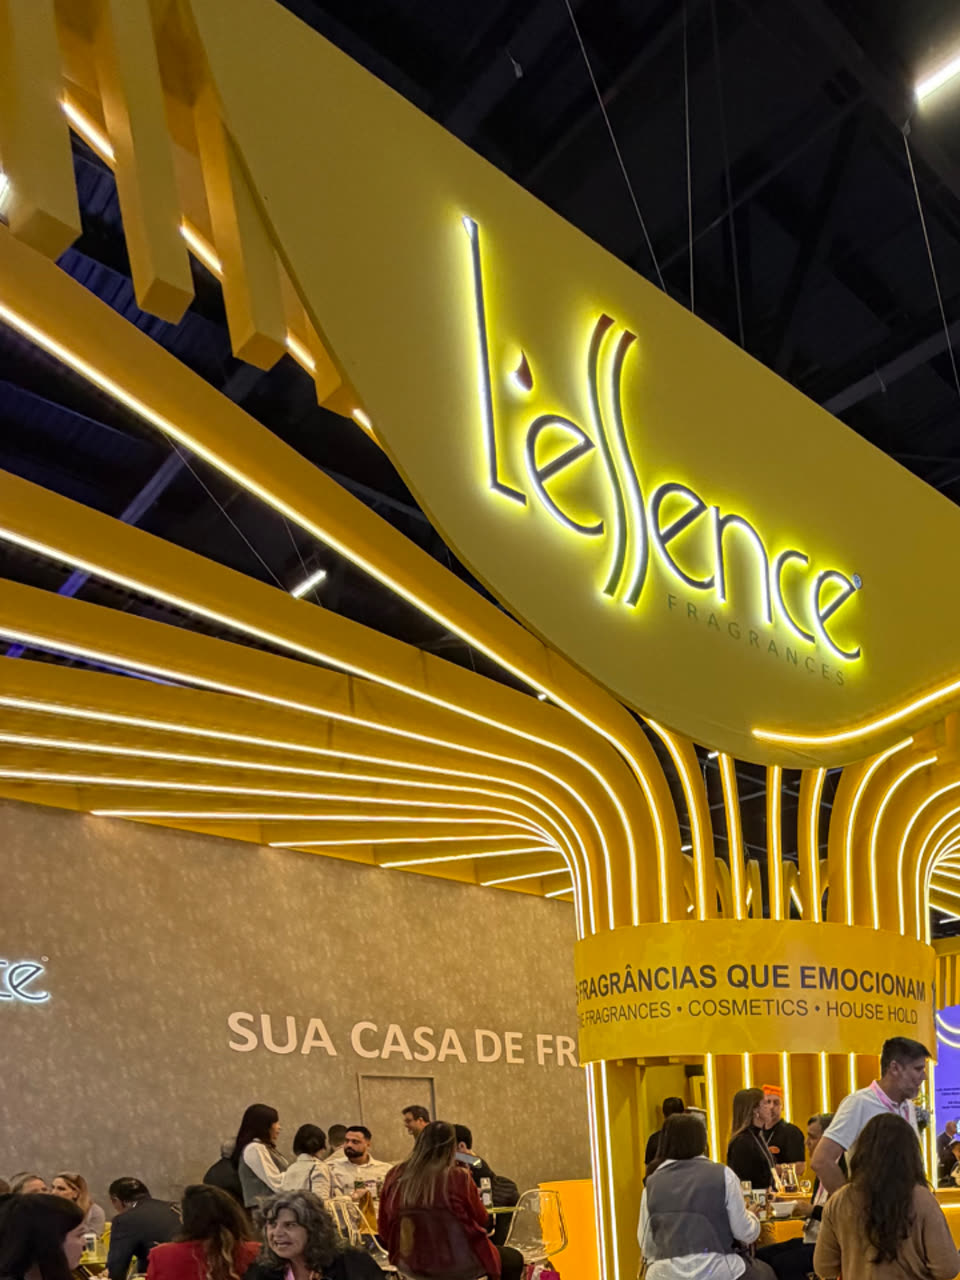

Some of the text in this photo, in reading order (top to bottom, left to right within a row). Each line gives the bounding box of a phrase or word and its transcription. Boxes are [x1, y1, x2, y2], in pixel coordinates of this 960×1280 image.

[667, 593, 846, 688] FRAGRANCES
[579, 963, 717, 1002] FRAGRÂNCIAS
[727, 964, 790, 990] QUE
[800, 965, 926, 1002] EMOCIONAM
[585, 1001, 671, 1025] FRAGRANCES
[688, 998, 808, 1017] COSMETICS
[827, 1000, 884, 1021] HOUSE
[888, 1005, 918, 1025] HOLD
[227, 1011, 338, 1057] SUA
[351, 1020, 467, 1064] CASA
[475, 1028, 525, 1065] DE
